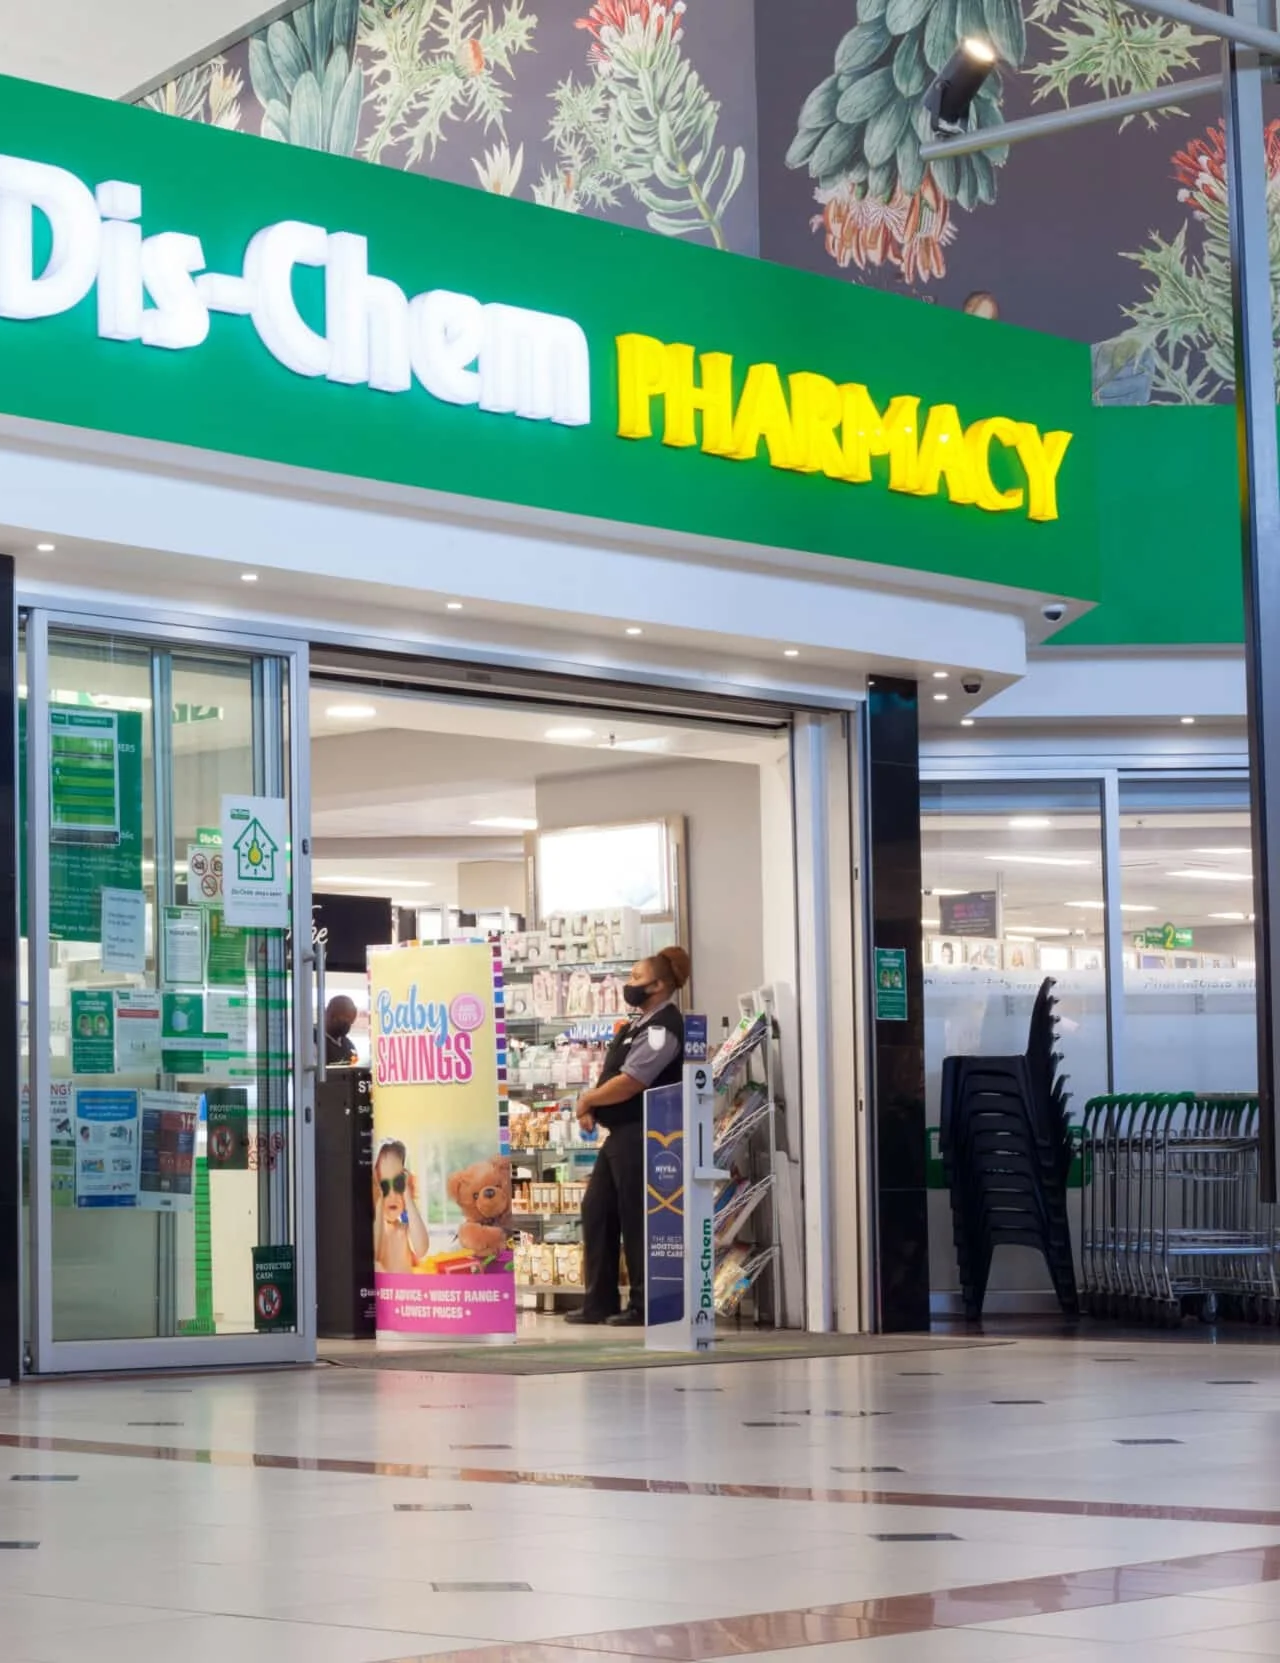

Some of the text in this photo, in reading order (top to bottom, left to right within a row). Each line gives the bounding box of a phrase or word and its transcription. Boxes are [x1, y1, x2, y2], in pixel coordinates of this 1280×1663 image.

[616, 333, 1073, 521] PHARMACY
[1164, 924, 1175, 949] 2
[378, 984, 448, 1048] Baby
[378, 1032, 472, 1083] SAVINGS
[655, 1165, 677, 1173] NIVEA
[255, 1262, 291, 1271] PROTECTED
[701, 1219, 712, 1308] Dis-Chem
[255, 1272, 273, 1280] CASH
[464, 1290, 499, 1303] RANGE
[401, 1306, 463, 1319] LOWEST PRICES
